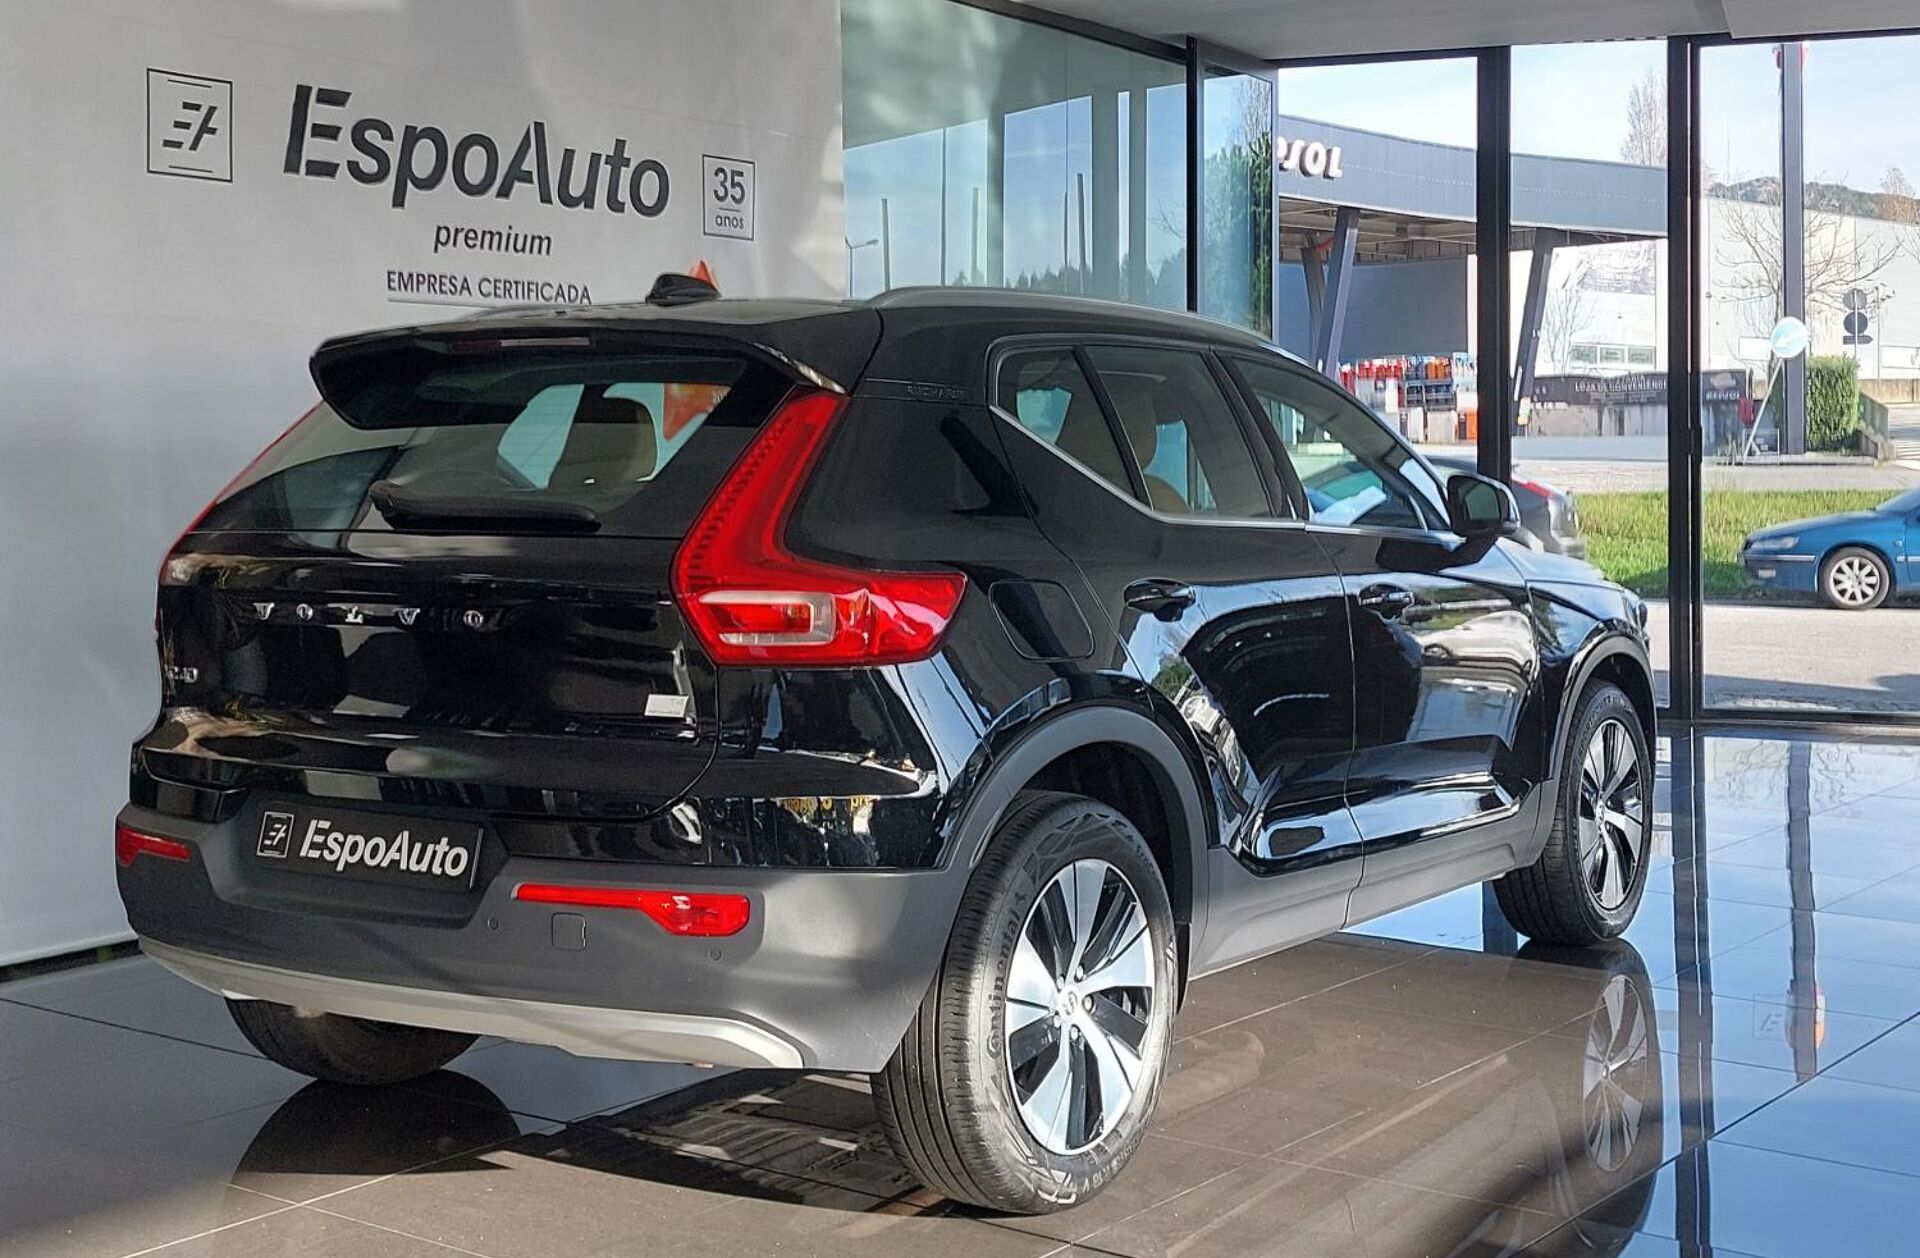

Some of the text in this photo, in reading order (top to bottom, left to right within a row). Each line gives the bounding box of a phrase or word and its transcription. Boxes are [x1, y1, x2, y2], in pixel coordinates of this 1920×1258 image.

[283, 83, 671, 217] EspoAuto
[713, 167, 746, 205] 35
[433, 222, 554, 256] premium
[714, 213, 745, 231] anos
[387, 270, 593, 305] EMPRESA CERTIFICADA
[253, 602, 484, 627] VOLVO
[299, 818, 469, 876] EspoAuto
[986, 908, 1022, 1057] Continental
